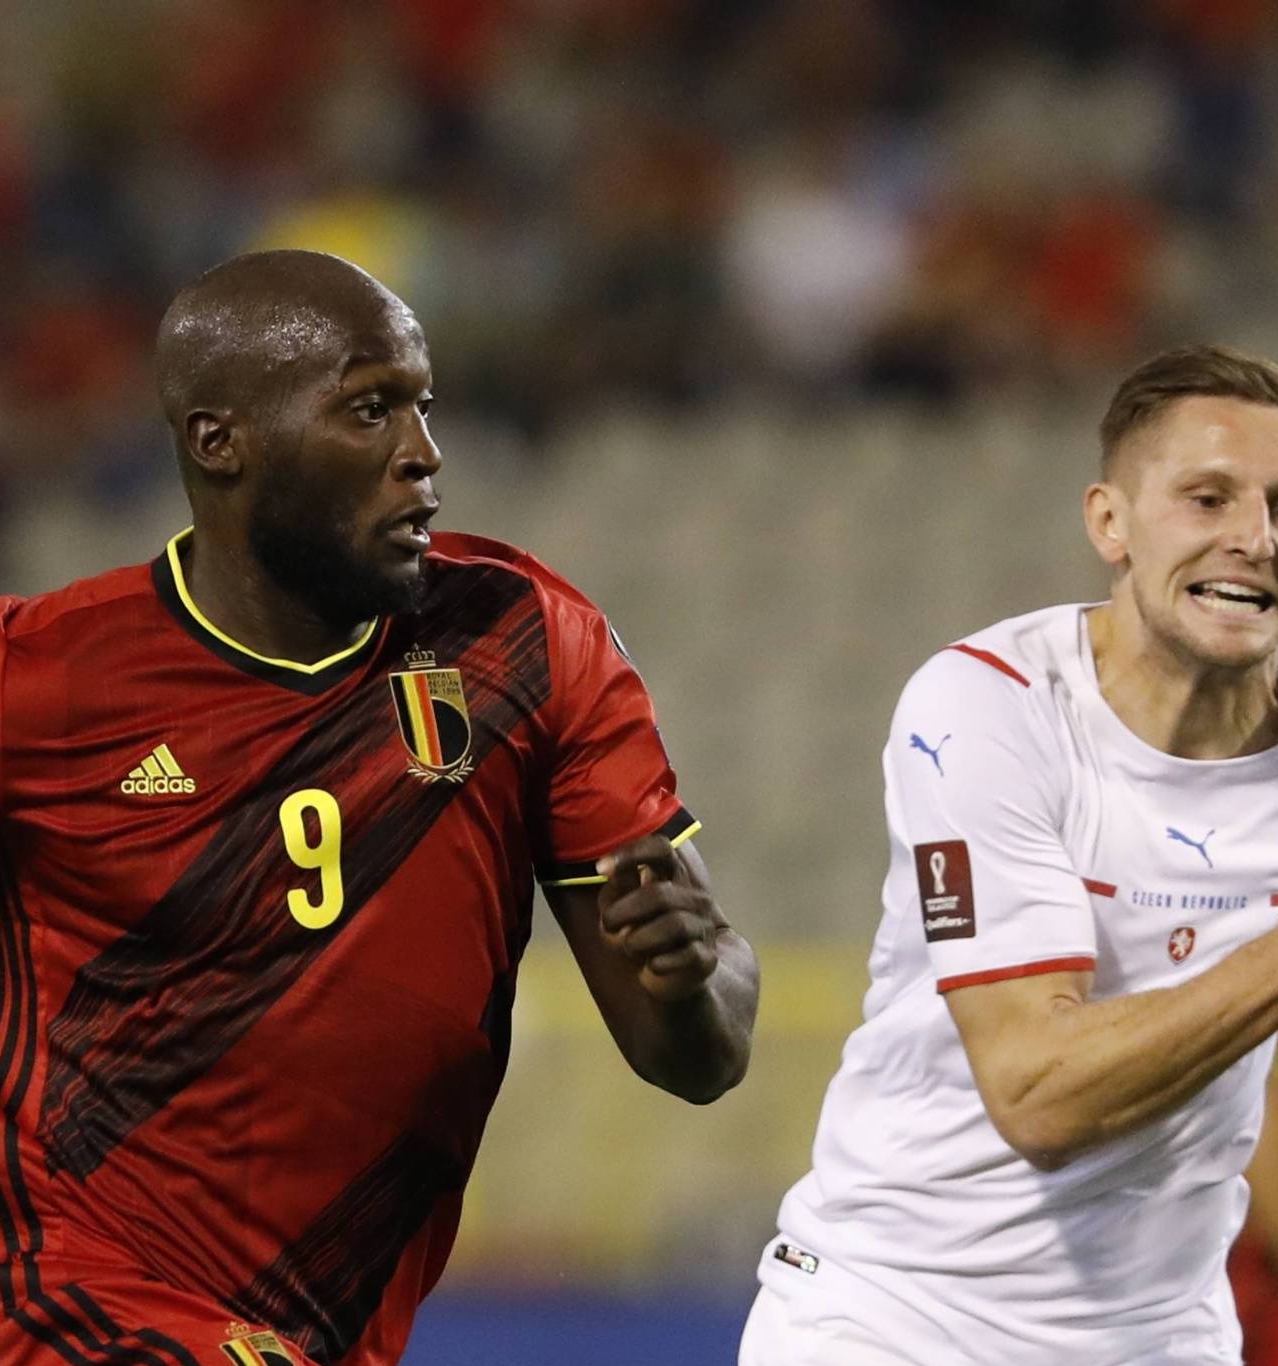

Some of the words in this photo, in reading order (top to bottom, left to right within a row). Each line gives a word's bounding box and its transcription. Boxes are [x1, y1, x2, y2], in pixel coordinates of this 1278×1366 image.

[120, 775, 197, 794] adidas
[279, 788, 344, 930] 9
[1132, 891, 1172, 908] CZECH
[1182, 895, 1249, 909] REPUBLIC
